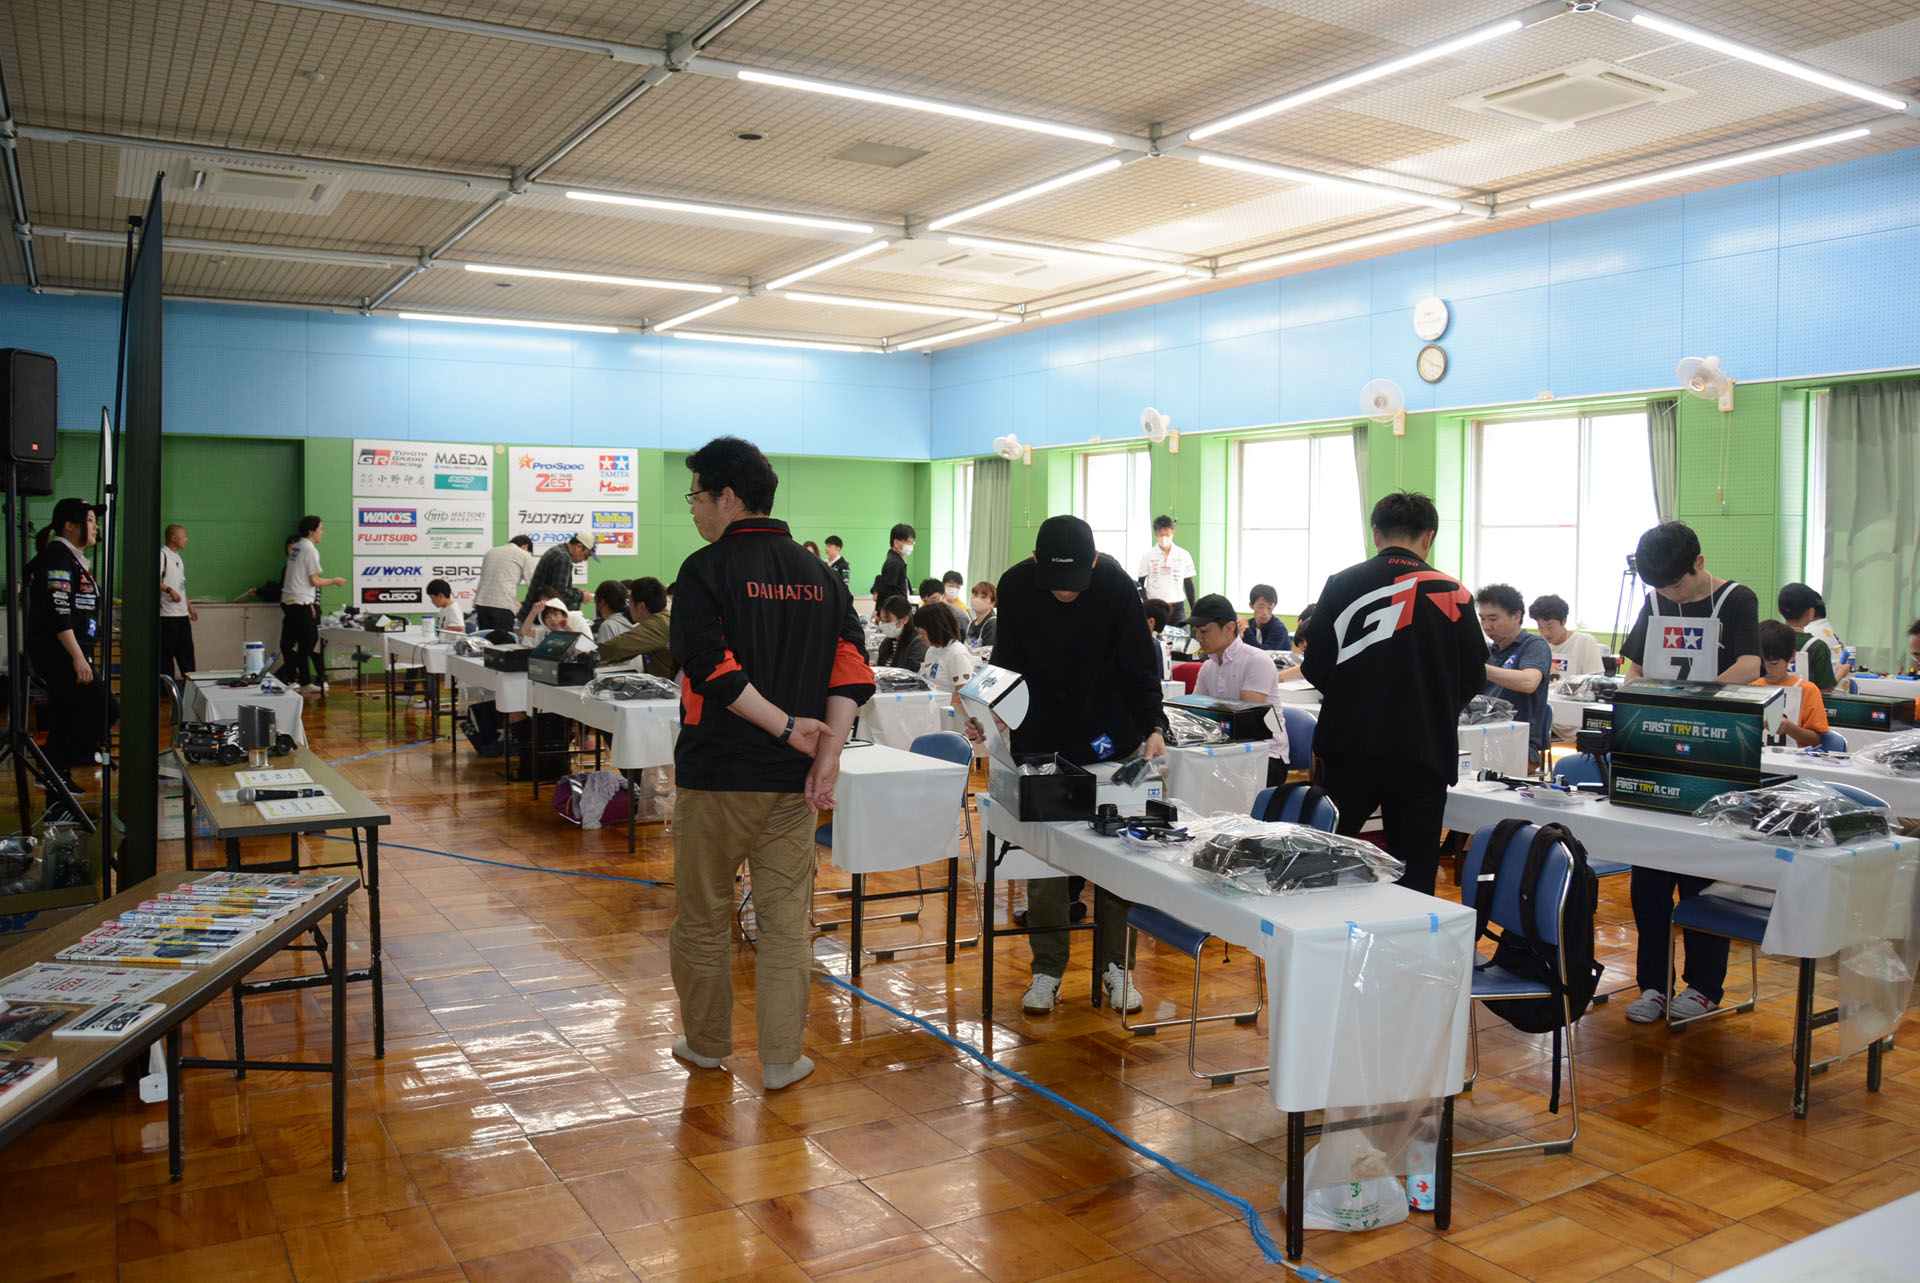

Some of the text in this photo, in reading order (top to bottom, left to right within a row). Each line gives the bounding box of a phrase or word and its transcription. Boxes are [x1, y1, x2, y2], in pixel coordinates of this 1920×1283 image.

[435, 453, 487, 465] MAEDA
[358, 534, 418, 542] FUJITSUBO
[1388, 557, 1420, 567] DENSO
[383, 566, 422, 576] WORK
[378, 592, 418, 601] CUSCO
[746, 581, 824, 601] DAIHATSU
[1642, 720, 1671, 734] FIRST
[1672, 723, 1692, 736] TRY
[1710, 727, 1728, 739] KIT
[1616, 780, 1638, 790] FIRST
[1639, 783, 1654, 792] TRY
[1667, 787, 1681, 796] KIT
